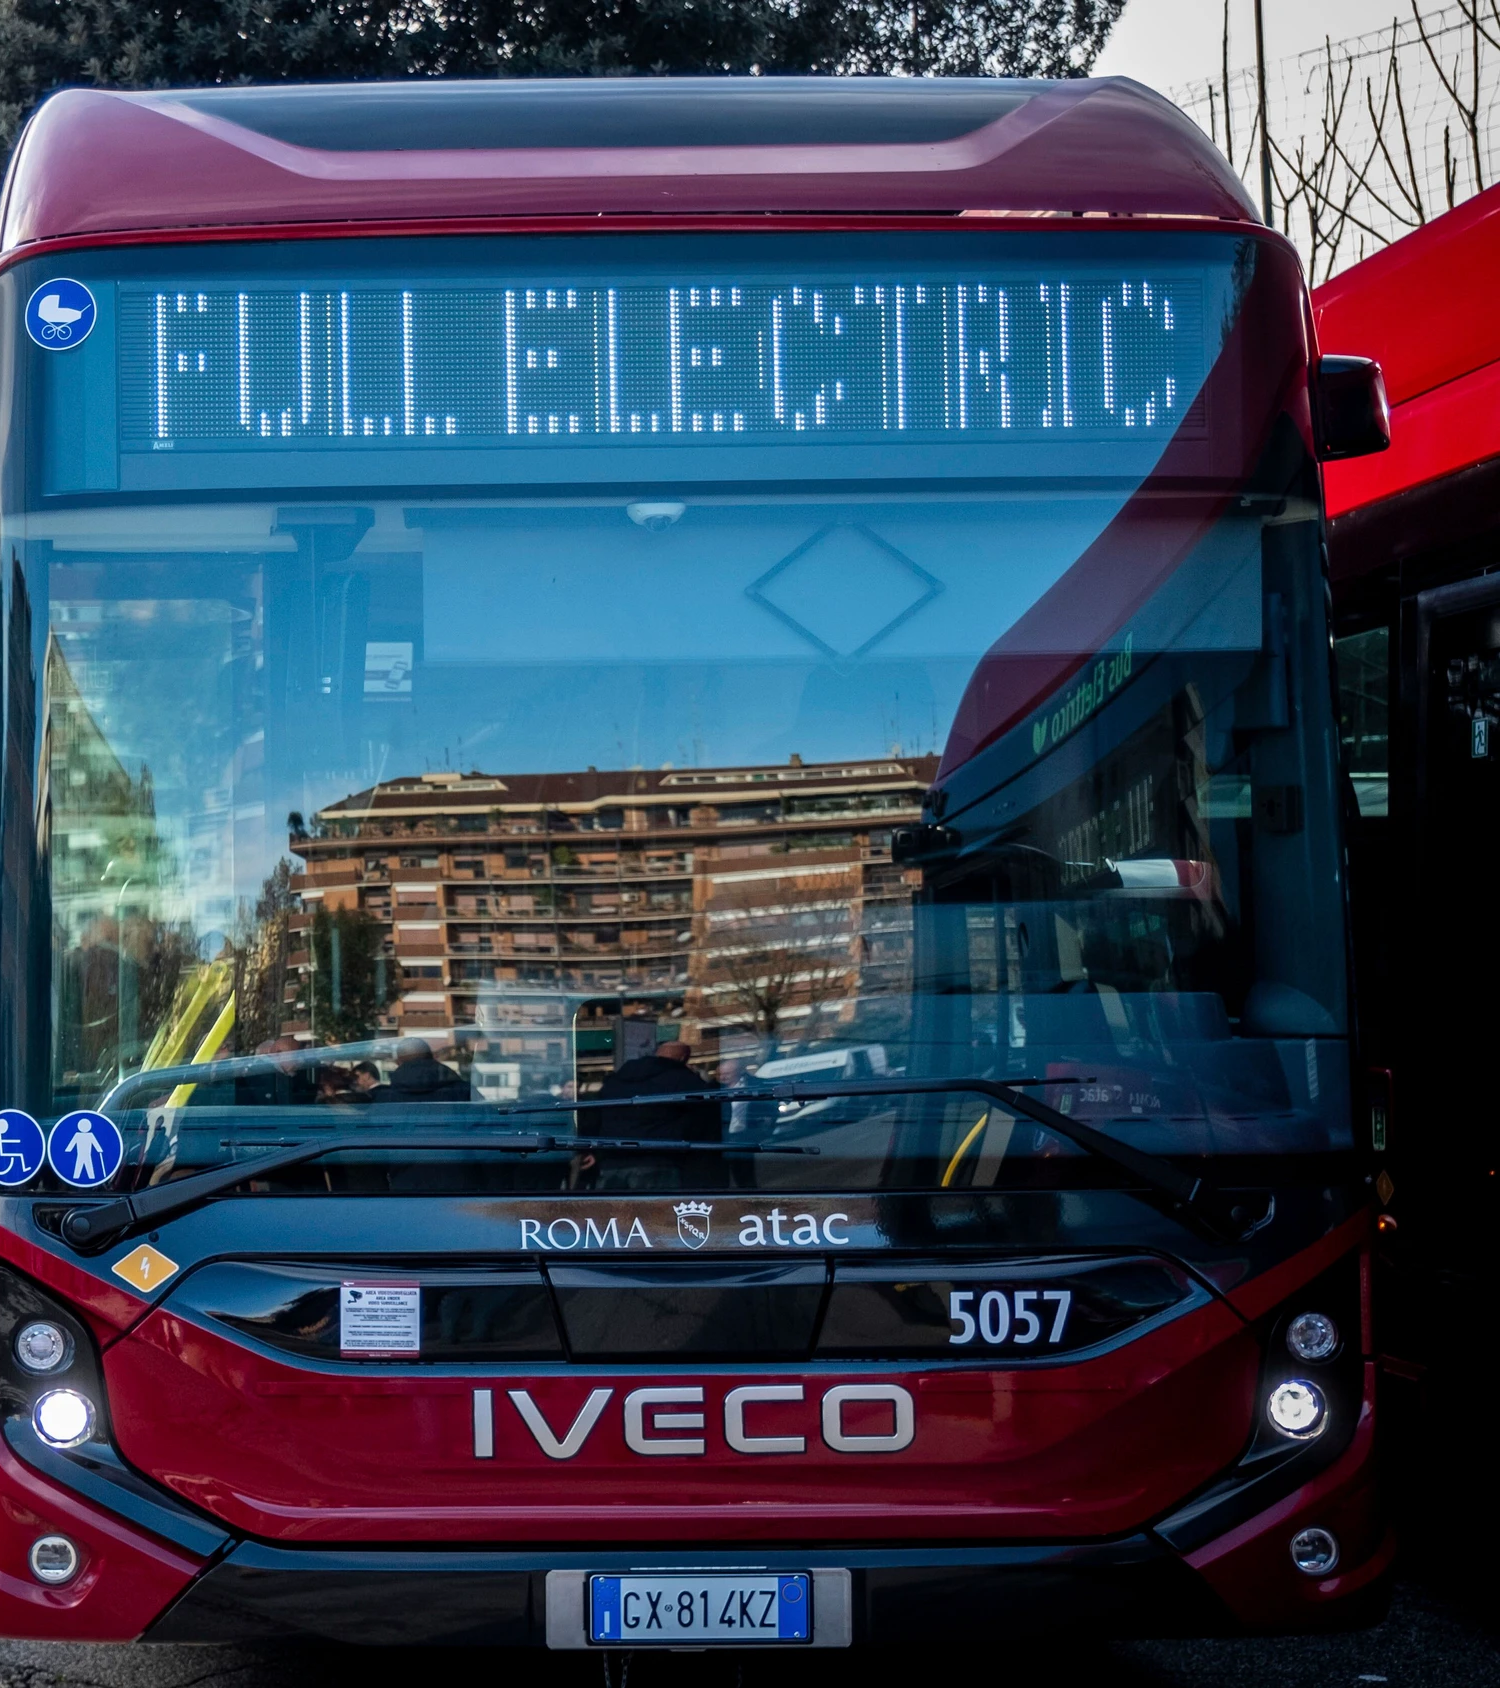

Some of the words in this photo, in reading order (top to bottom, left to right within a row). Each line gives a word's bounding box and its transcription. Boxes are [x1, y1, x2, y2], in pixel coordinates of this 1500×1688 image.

[155, 292, 457, 438] FULL
[505, 282, 1176, 435] ELECTRIC
[519, 1217, 653, 1250] ROMA
[738, 1208, 850, 1246] atac
[949, 1291, 1071, 1345] 5057
[473, 1384, 914, 1459] IVECO
